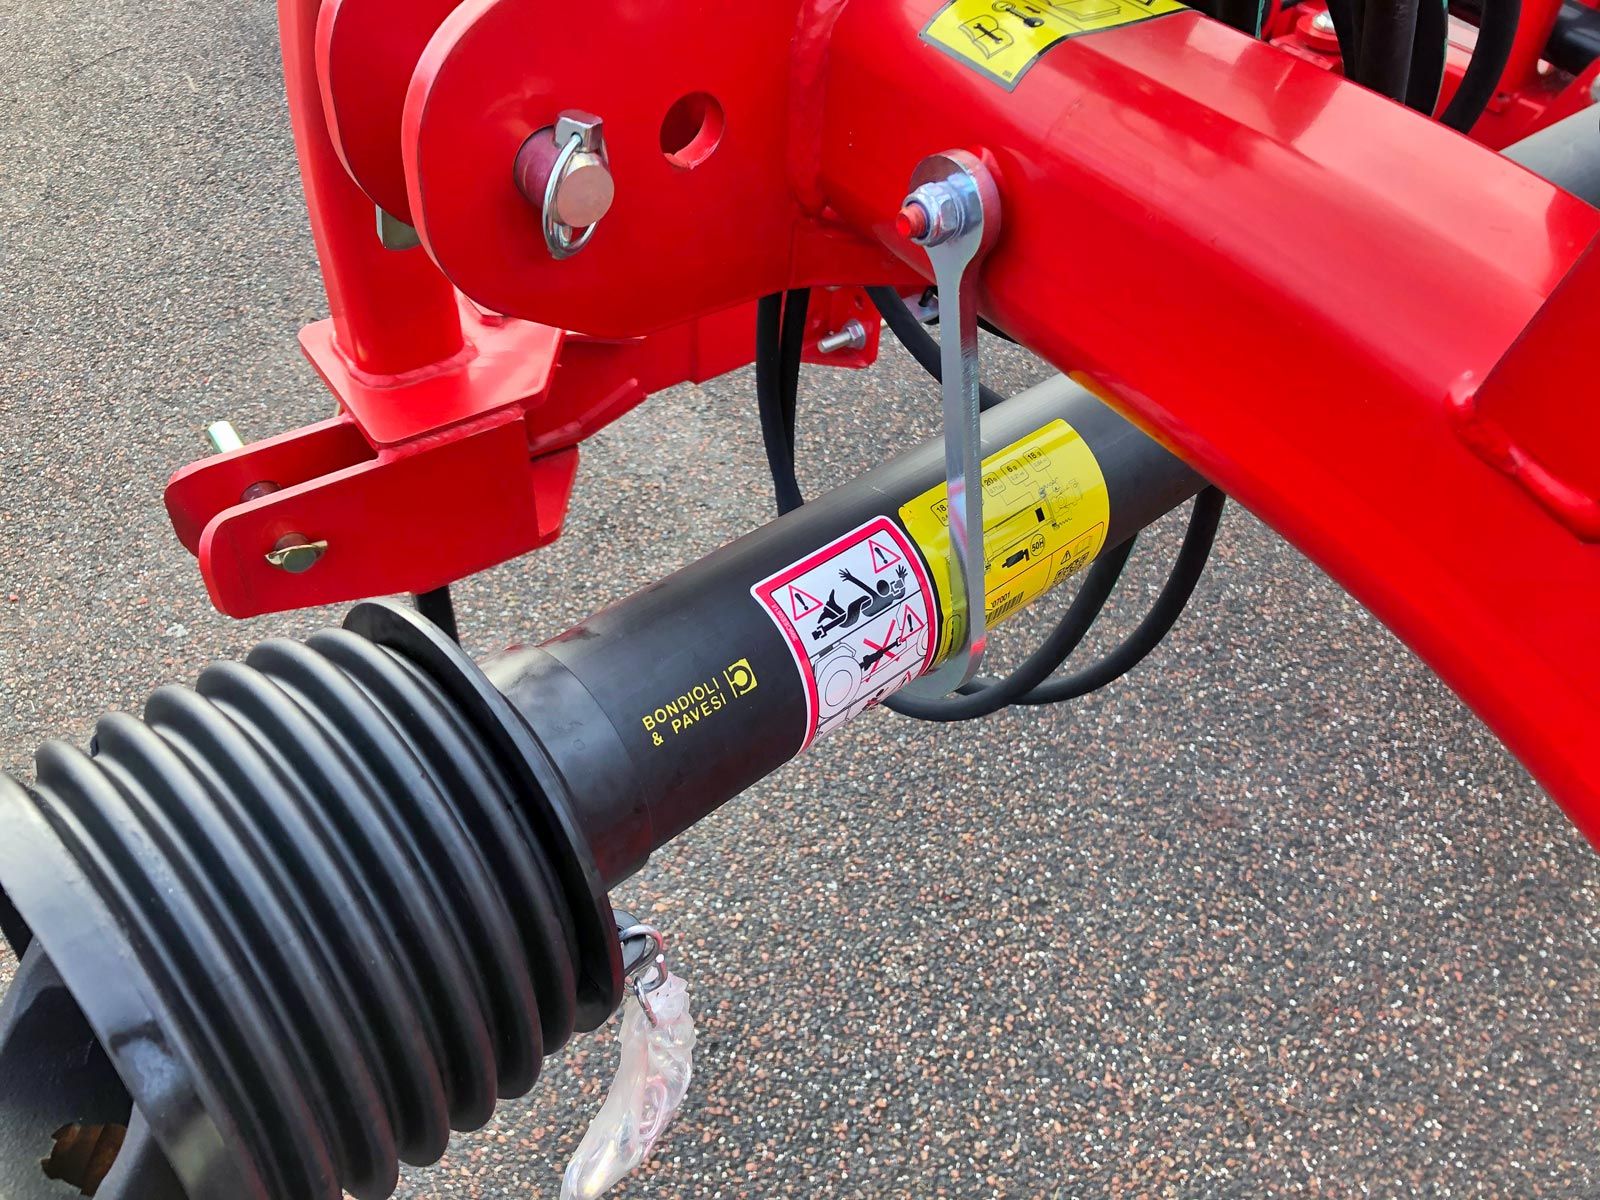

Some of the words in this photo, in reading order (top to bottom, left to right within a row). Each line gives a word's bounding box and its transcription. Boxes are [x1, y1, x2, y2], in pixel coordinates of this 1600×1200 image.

[641, 676, 720, 731] BONDIOLI
[651, 731, 664, 746] &
[671, 692, 727, 734] PAVESI
